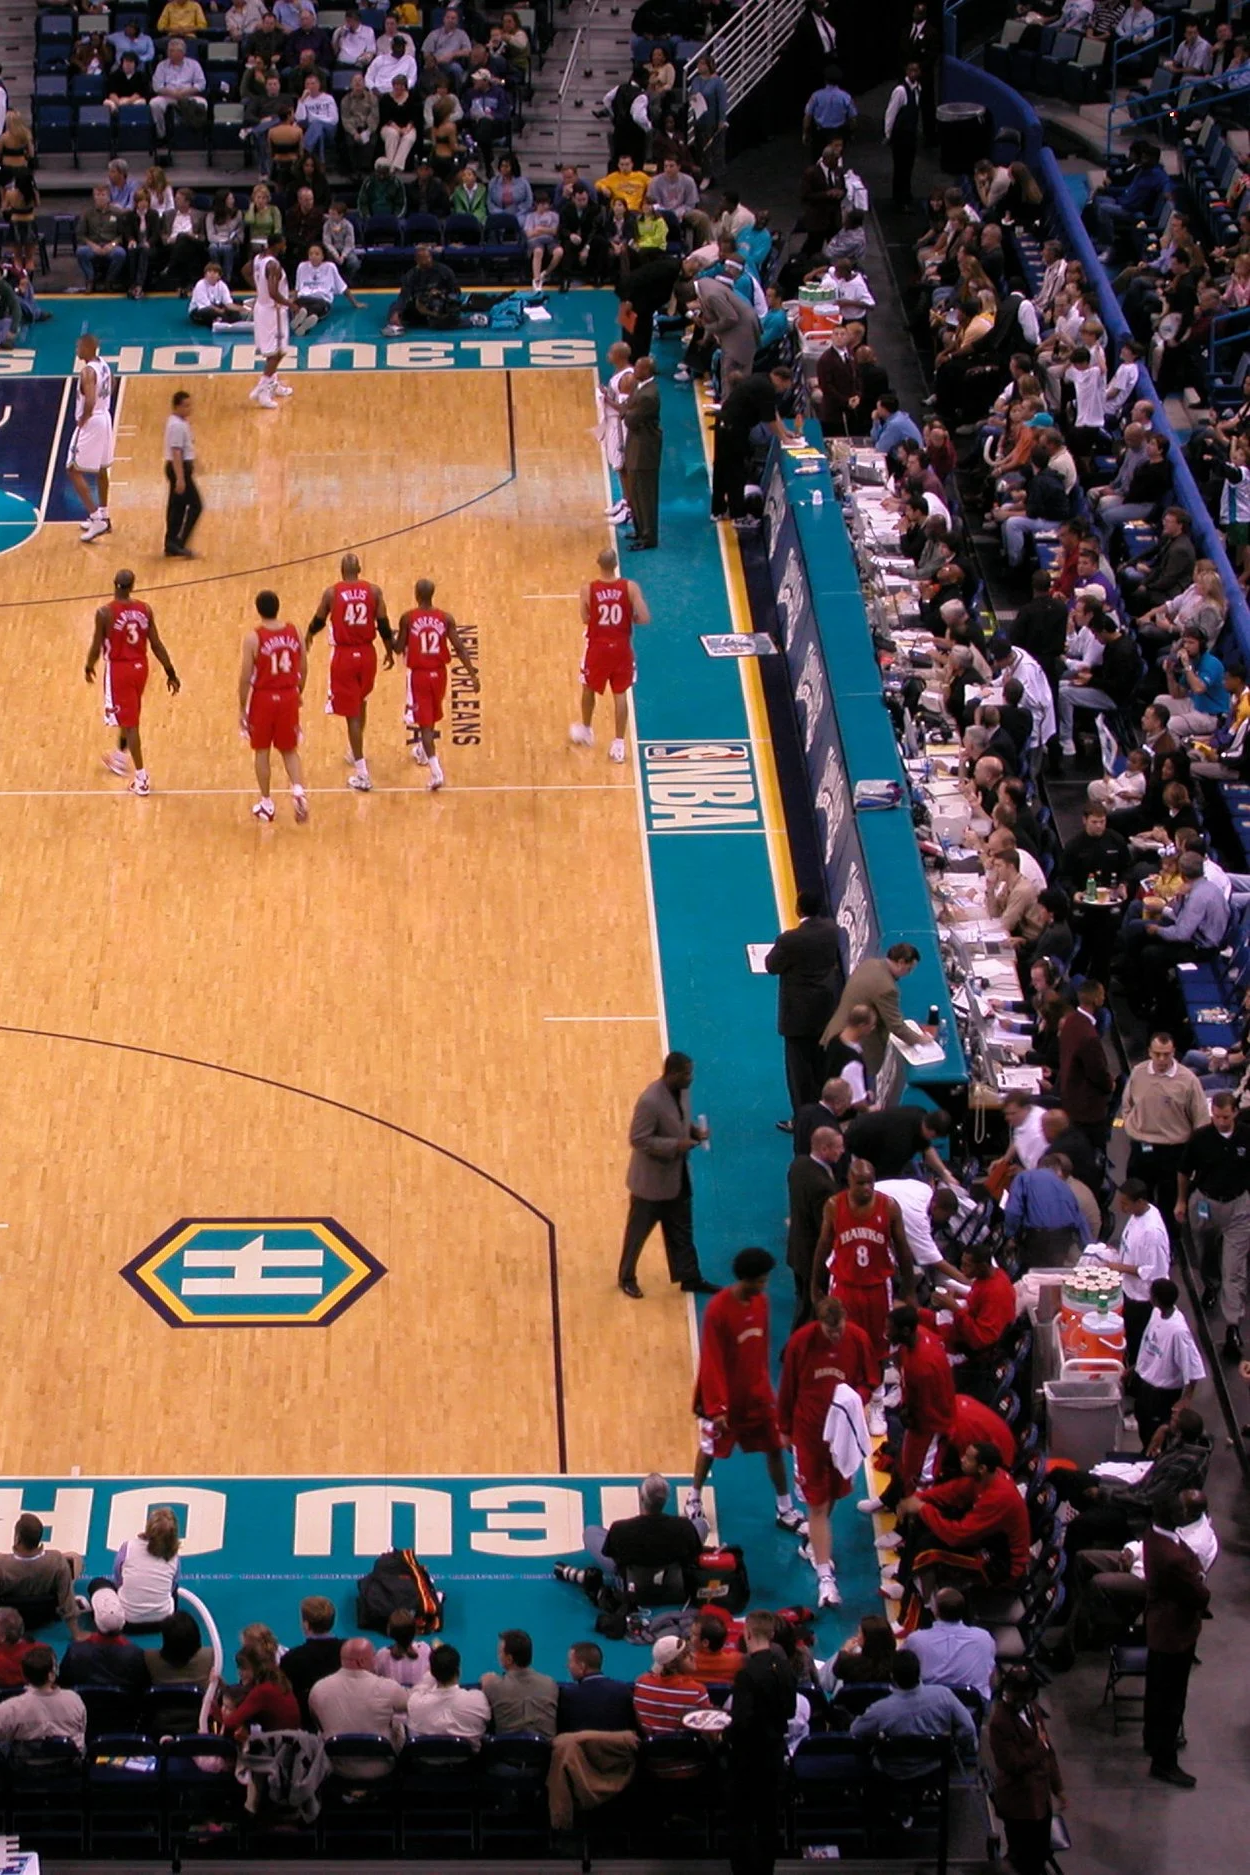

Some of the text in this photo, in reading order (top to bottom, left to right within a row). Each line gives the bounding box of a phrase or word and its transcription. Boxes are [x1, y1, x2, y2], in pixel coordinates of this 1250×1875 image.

[344, 602, 368, 625] 42
[598, 603, 623, 626] 20
[126, 622, 140, 645] 3
[419, 630, 441, 654] 12
[270, 649, 292, 676] 14
[450, 665, 481, 746] ORLEANS
[645, 760, 759, 829] NBA
[840, 1226, 885, 1245] HAWKS
[856, 1245, 870, 1267] 8
